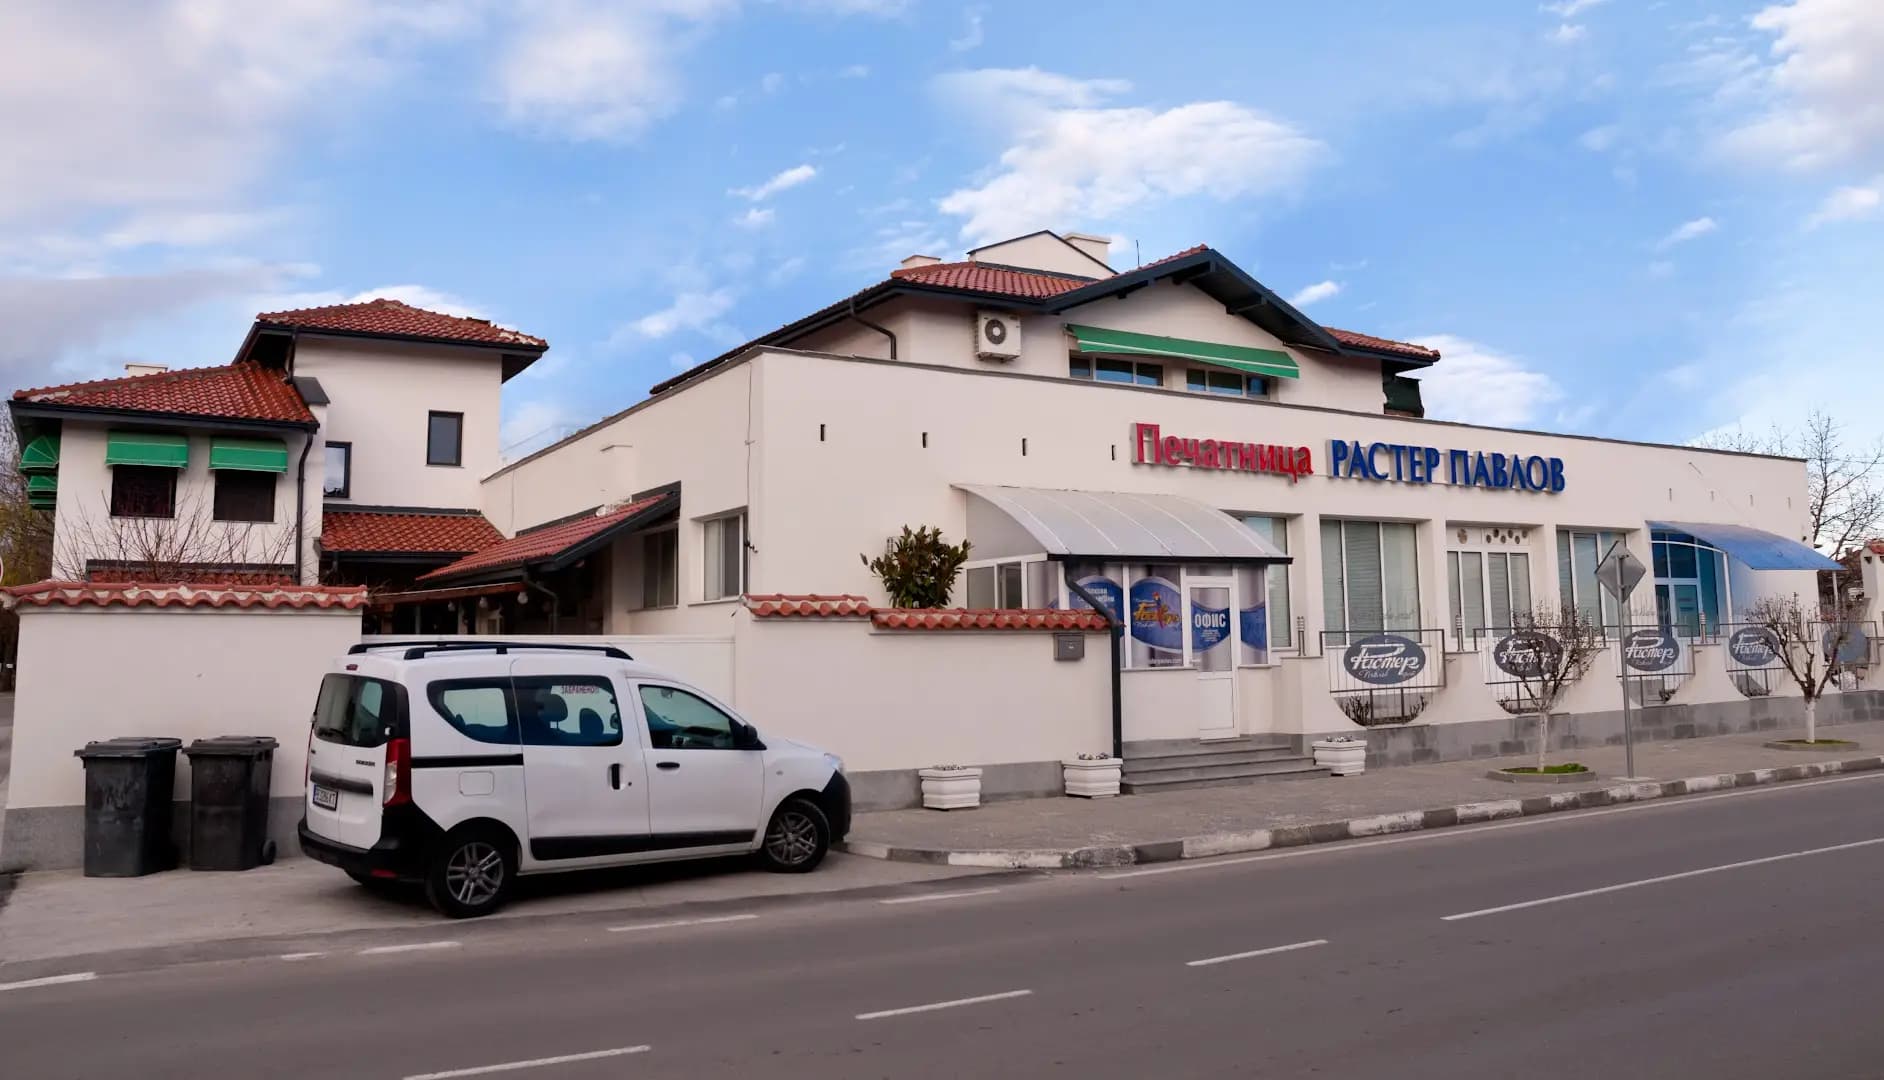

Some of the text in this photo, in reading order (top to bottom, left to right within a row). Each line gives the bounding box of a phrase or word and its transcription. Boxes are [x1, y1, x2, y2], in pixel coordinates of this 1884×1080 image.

[1133, 422, 1566, 493] Печатница РАСТЕР ПАВЛОВ
[1194, 613, 1227, 628] ОФИС
